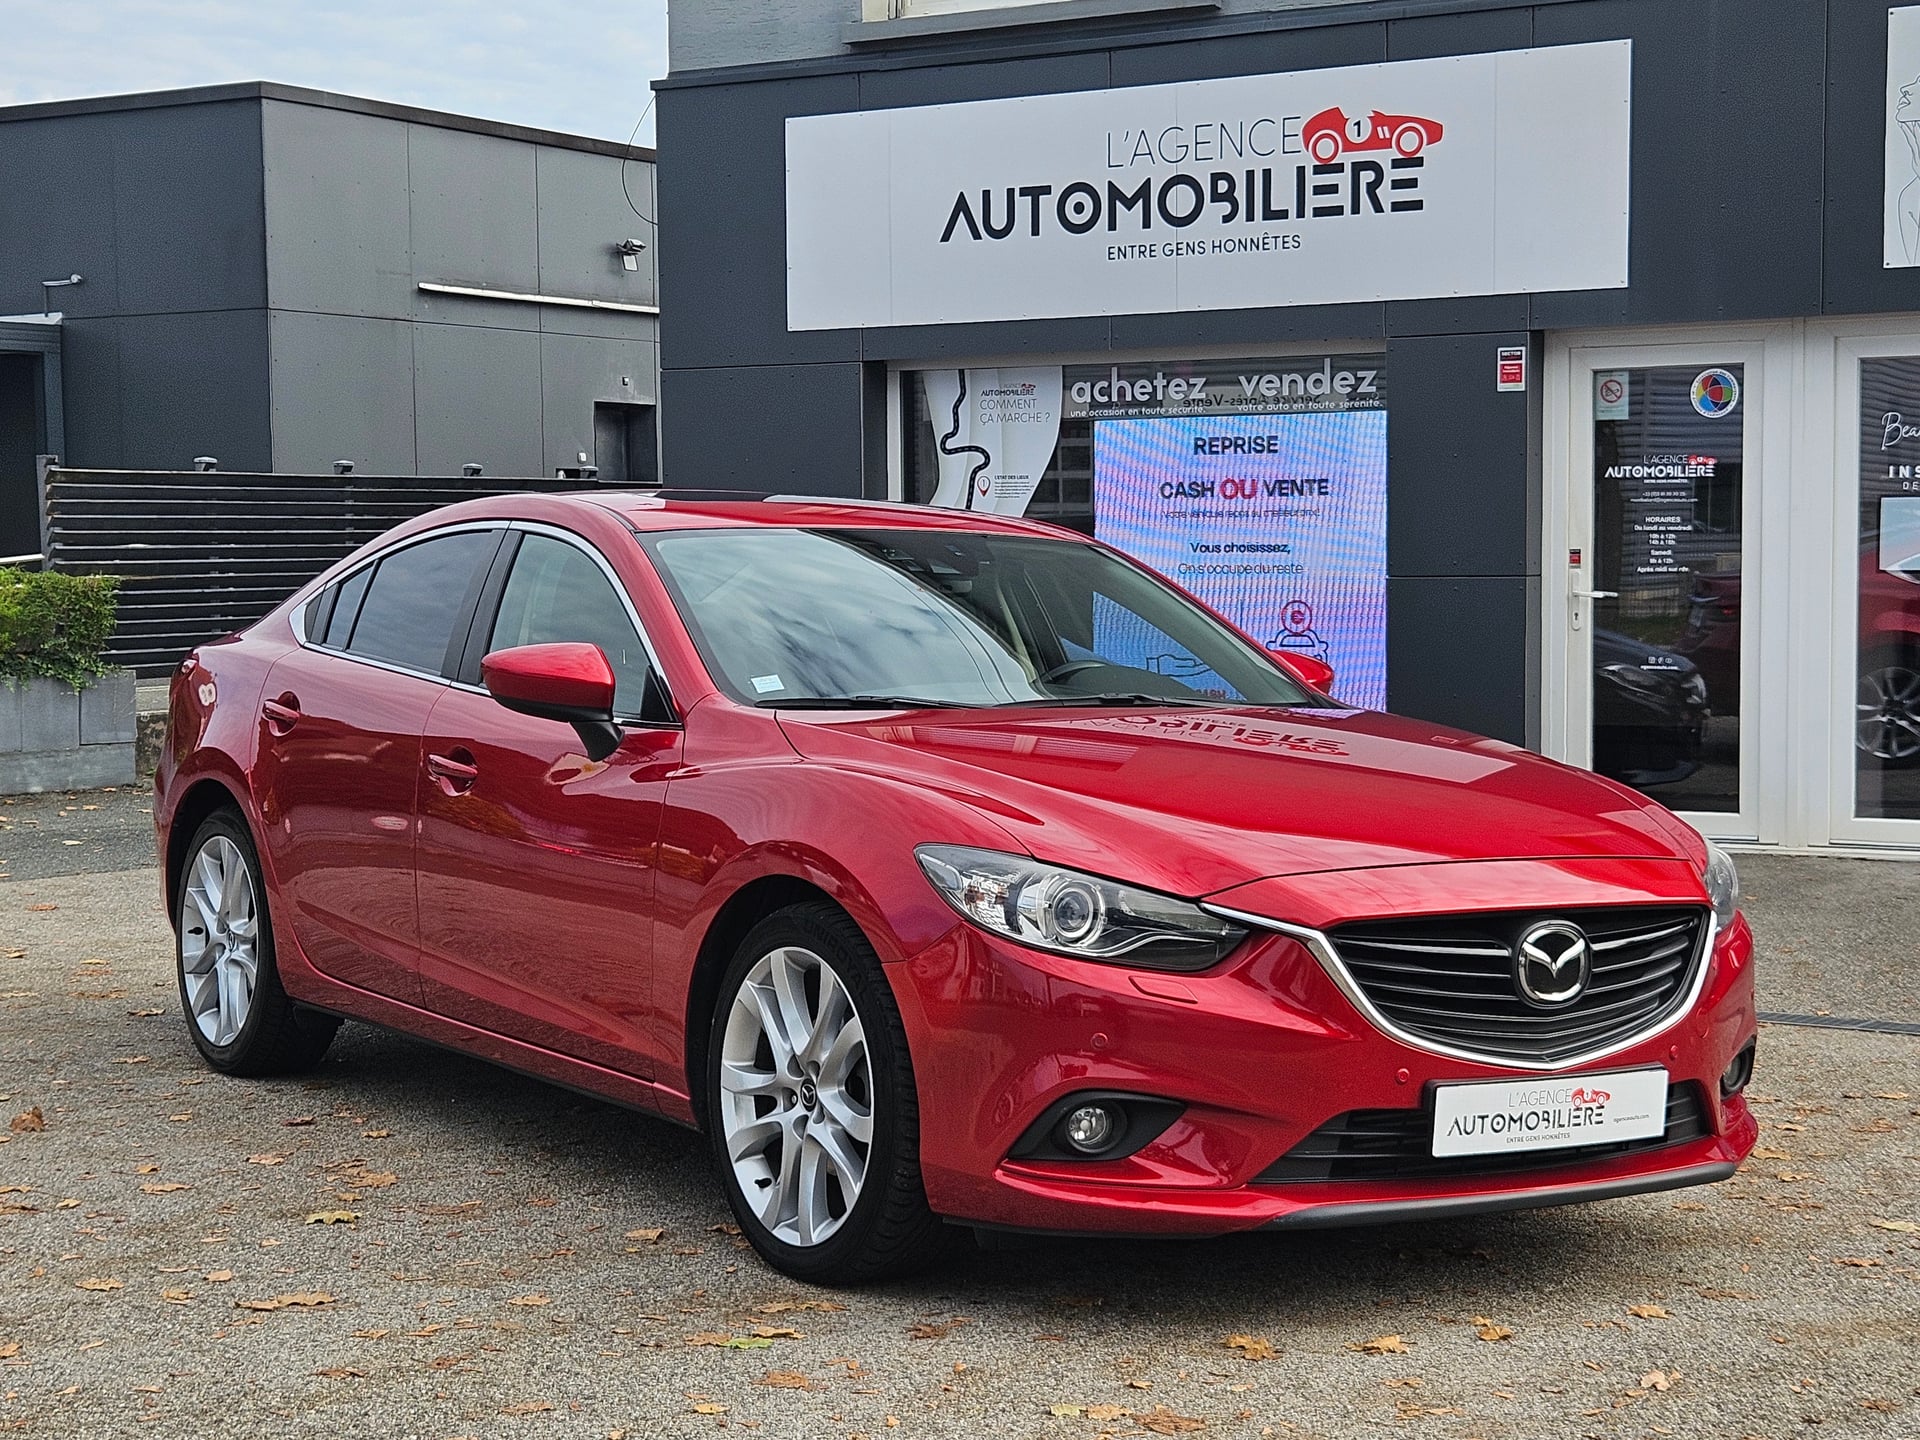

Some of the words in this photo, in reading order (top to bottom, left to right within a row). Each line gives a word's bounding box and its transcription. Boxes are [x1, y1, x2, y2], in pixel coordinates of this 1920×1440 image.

[1107, 115, 1302, 168] L'AGENCE
[939, 155, 1425, 244] AUTOMOBILIERE
[1107, 244, 1157, 261] ENTRE
[1161, 240, 1207, 259] GENS
[1211, 232, 1302, 255] HONNÊTES
[1070, 366, 1207, 404] achetez
[1238, 357, 1378, 397] vendez
[980, 399, 1037, 410] COMMENT
[1070, 410, 1088, 418] une
[1088, 408, 1126, 417] occasion
[1128, 408, 1140, 416] en
[1141, 406, 1167, 415] toute
[1237, 404, 1265, 412] votre
[1266, 403, 1289, 411] auto
[1307, 400, 1336, 410] toute
[980, 412, 995, 425] ÇA
[996, 412, 1042, 423] MARCHE
[1045, 412, 1051, 423] ?
[1193, 436, 1279, 455] REPRISE
[1160, 481, 1215, 500] CASH
[1220, 478, 1258, 500] OU
[1263, 478, 1329, 497] VENTE
[1190, 542, 1222, 554] Vous
[1178, 563, 1196, 575] On
[1253, 563, 1271, 574] du
[1273, 563, 1304, 574] reste
[1508, 1088, 1572, 1108] L'AGENCE
[1447, 1105, 1605, 1137] AUTOMOBILIERE
[1525, 1134, 1541, 1142] GENS
[1541, 1131, 1570, 1141] HONNÊTES
